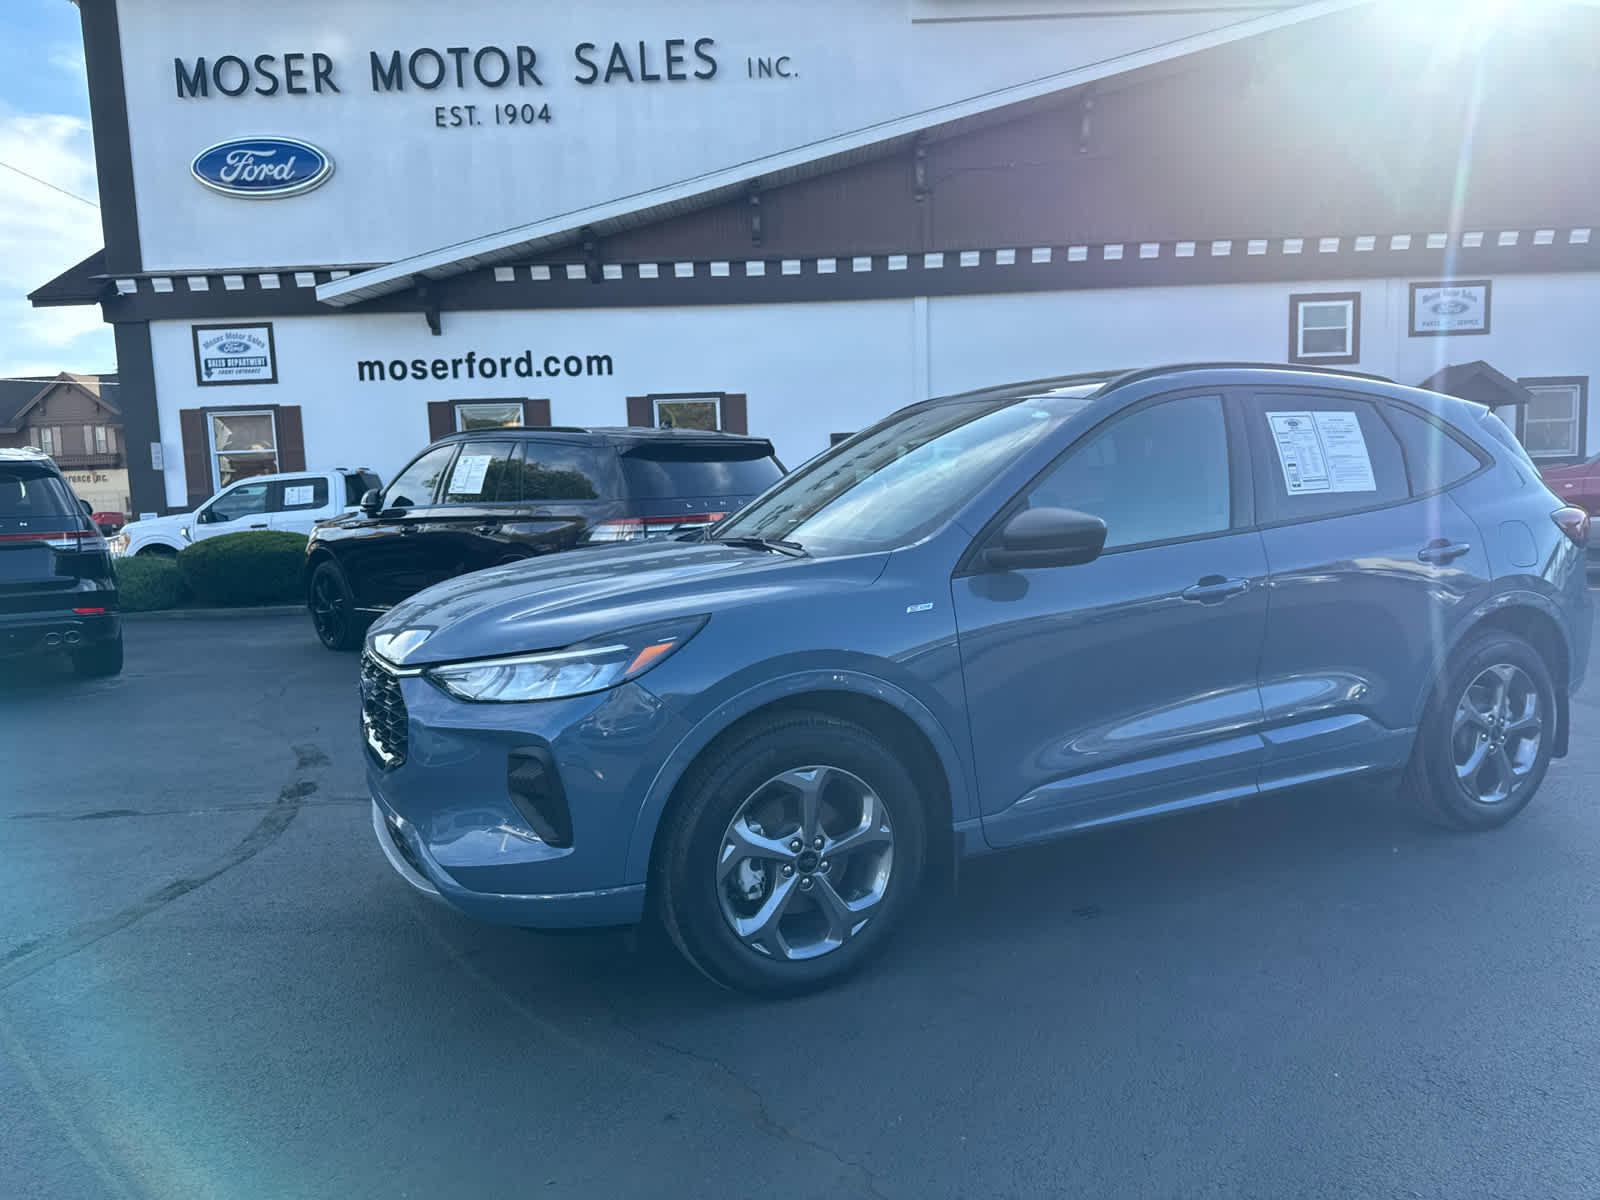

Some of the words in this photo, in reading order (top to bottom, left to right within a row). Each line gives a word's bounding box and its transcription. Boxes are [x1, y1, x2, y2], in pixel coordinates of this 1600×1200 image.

[174, 52, 341, 98] MOSER
[370, 44, 545, 91] MOTOR
[574, 37, 720, 85] SALES
[747, 55, 800, 79] INC.
[435, 105, 481, 127] EST.
[495, 103, 552, 125] 1904
[220, 149, 296, 182] Ford
[358, 350, 614, 382] moserford.com
